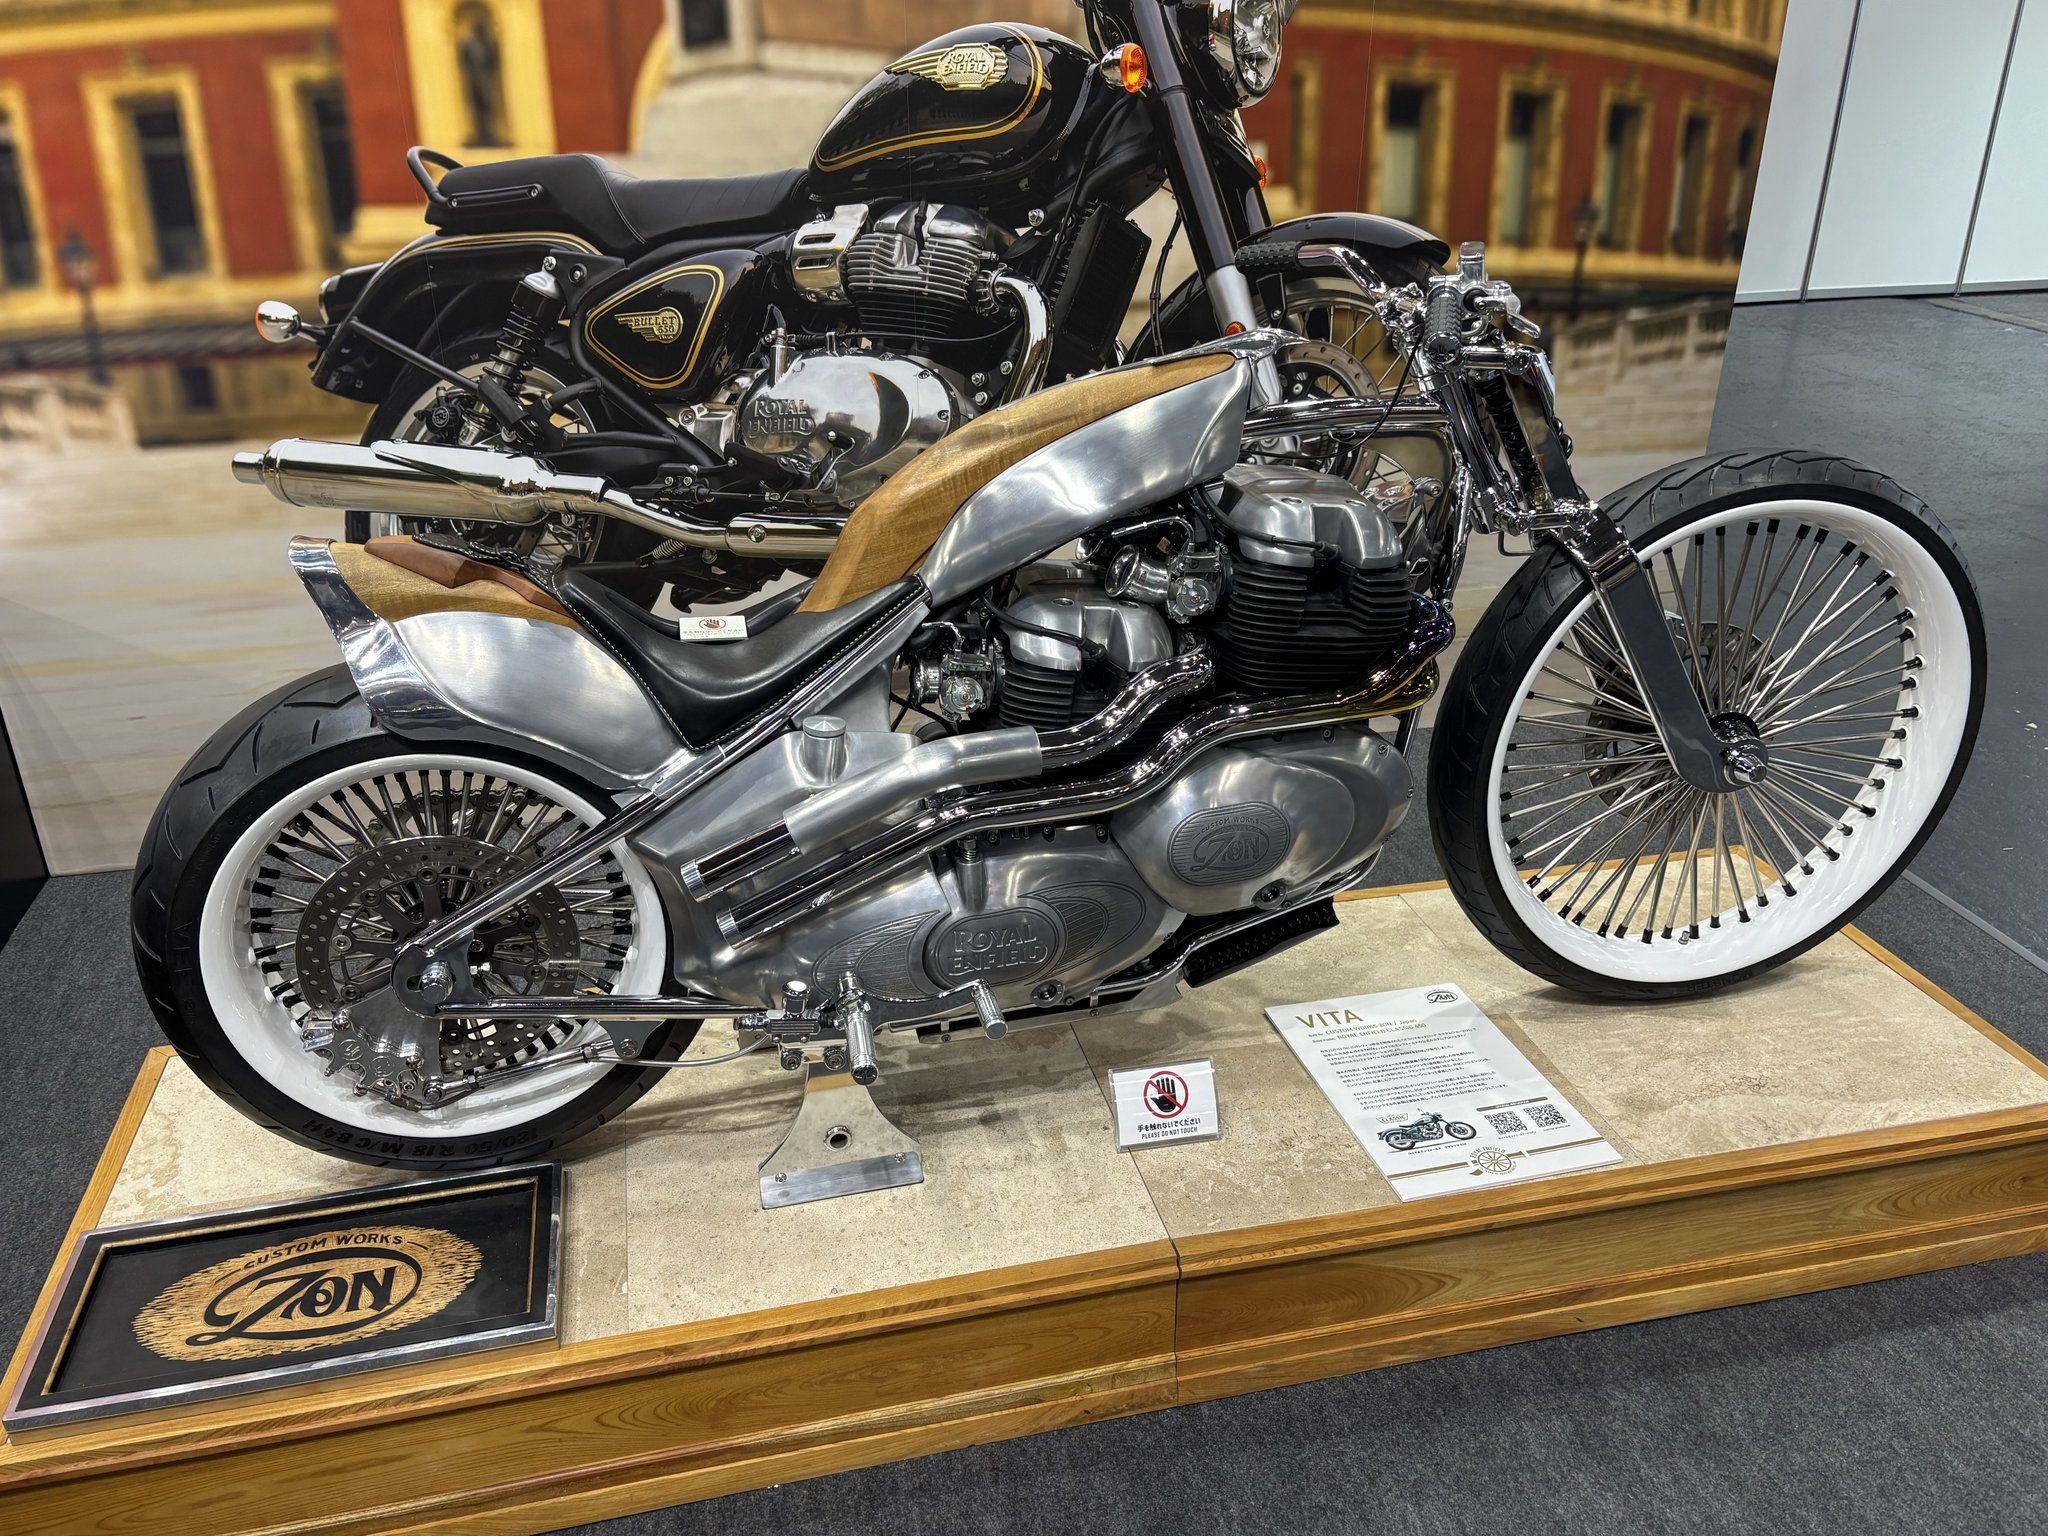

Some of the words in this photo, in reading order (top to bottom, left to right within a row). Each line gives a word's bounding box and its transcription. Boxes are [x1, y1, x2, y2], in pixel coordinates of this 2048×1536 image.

[948, 52, 985, 63] ROYAL
[941, 62, 989, 76] ENFIELD
[634, 316, 677, 327] BULLET
[658, 325, 675, 334] 650
[754, 400, 807, 417] ROYAL
[749, 417, 816, 438] ENFIELD
[1201, 817, 1230, 833] CUSTOM
[1233, 815, 1260, 825] WORKS
[1193, 834, 1260, 869] ZON
[953, 925, 1037, 953] ROYAL
[948, 945, 1048, 975] ENFIELD
[1295, 1009, 1364, 1029] VITA
[1325, 1027, 1353, 1036] CUSTOM
[1354, 1023, 1378, 1032] WORKS
[1337, 1032, 1357, 1040] ROYAL
[1359, 1029, 1385, 1037] ENFIELD
[303, 1119, 353, 1143] 84H
[1137, 1118, 1200, 1133] 手を触れないでください
[1142, 1131, 1161, 1140] PLEASE
[1169, 1128, 1180, 1136] NOT
[1180, 1126, 1198, 1135] TOUCH
[355, 1137, 404, 1154] M/C
[413, 1144, 455, 1156] R18
[243, 1237, 328, 1269] CUSTOM
[335, 1233, 404, 1247] WORKS
[195, 1264, 399, 1343] ZON
